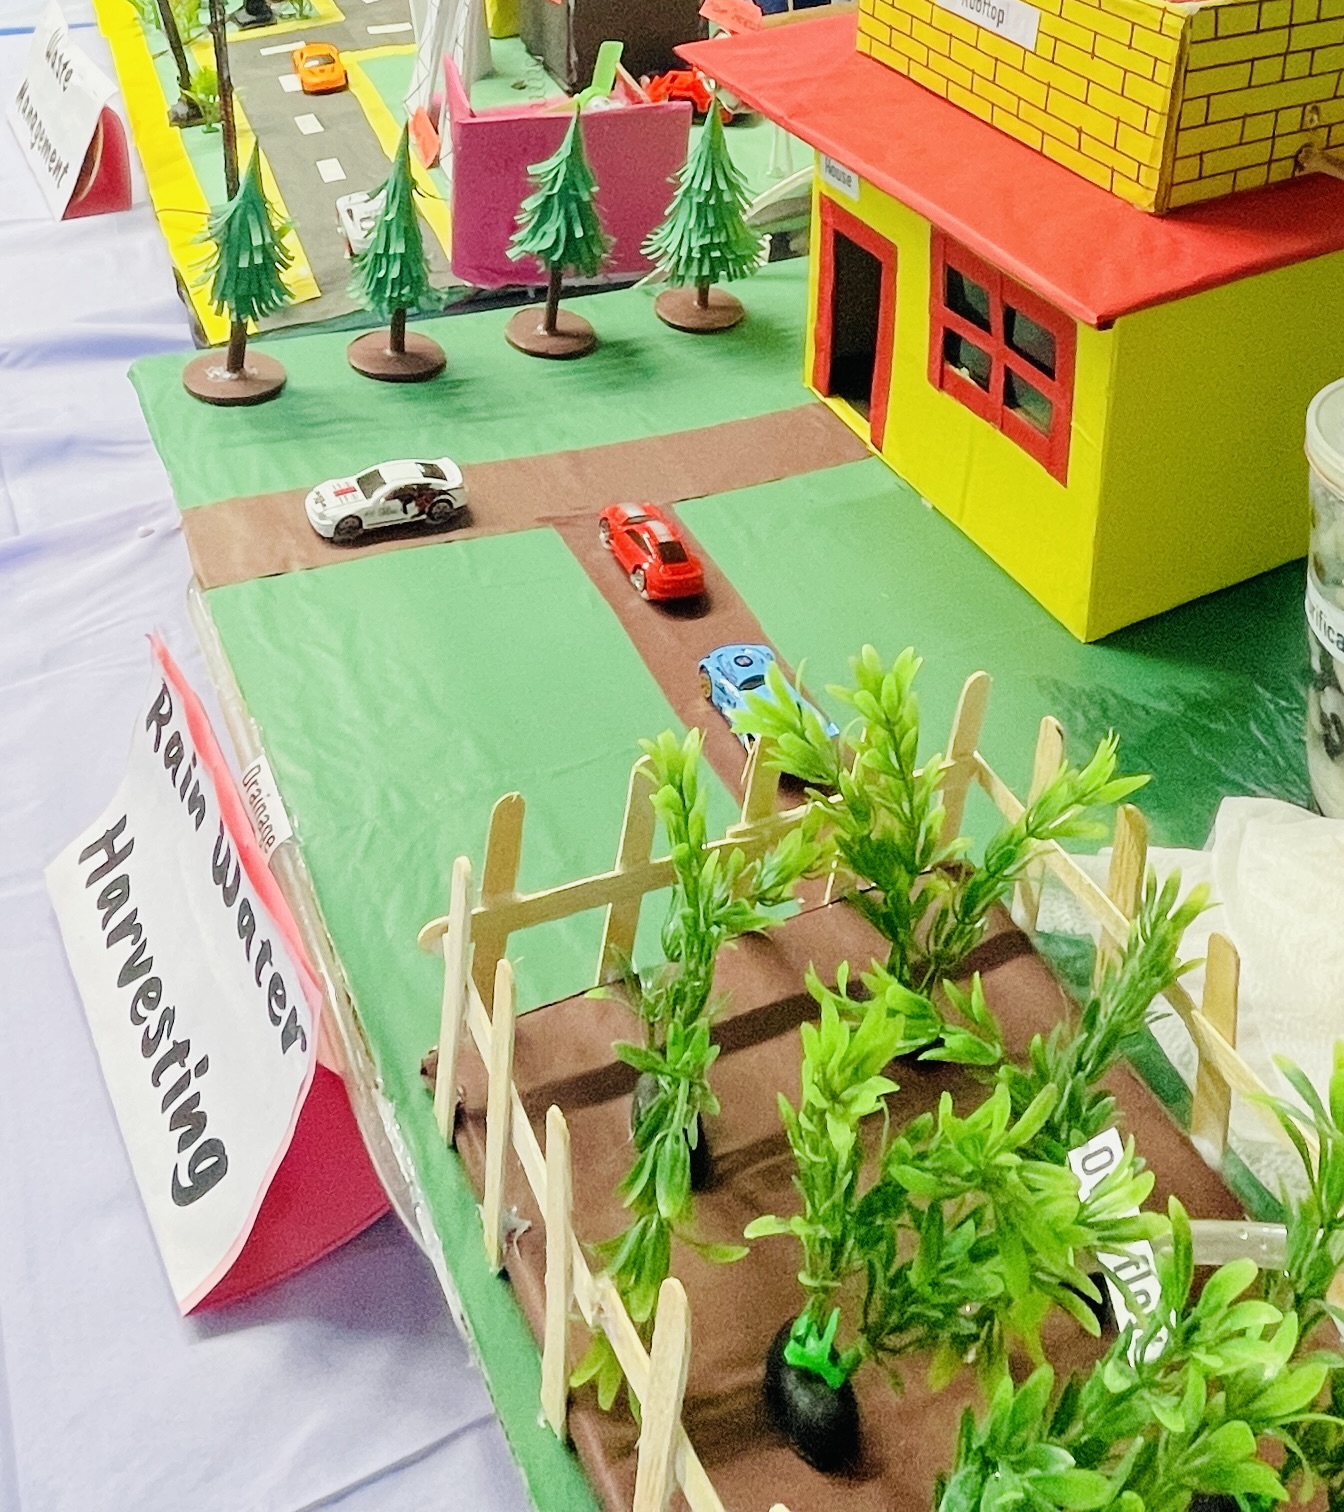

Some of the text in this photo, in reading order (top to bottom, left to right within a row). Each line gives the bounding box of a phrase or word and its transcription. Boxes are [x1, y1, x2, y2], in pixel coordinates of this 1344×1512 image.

[824, 156, 852, 188] House
[146, 677, 206, 831] Rain
[242, 764, 276, 854] Drainage
[78, 813, 229, 1207] Harvesting
